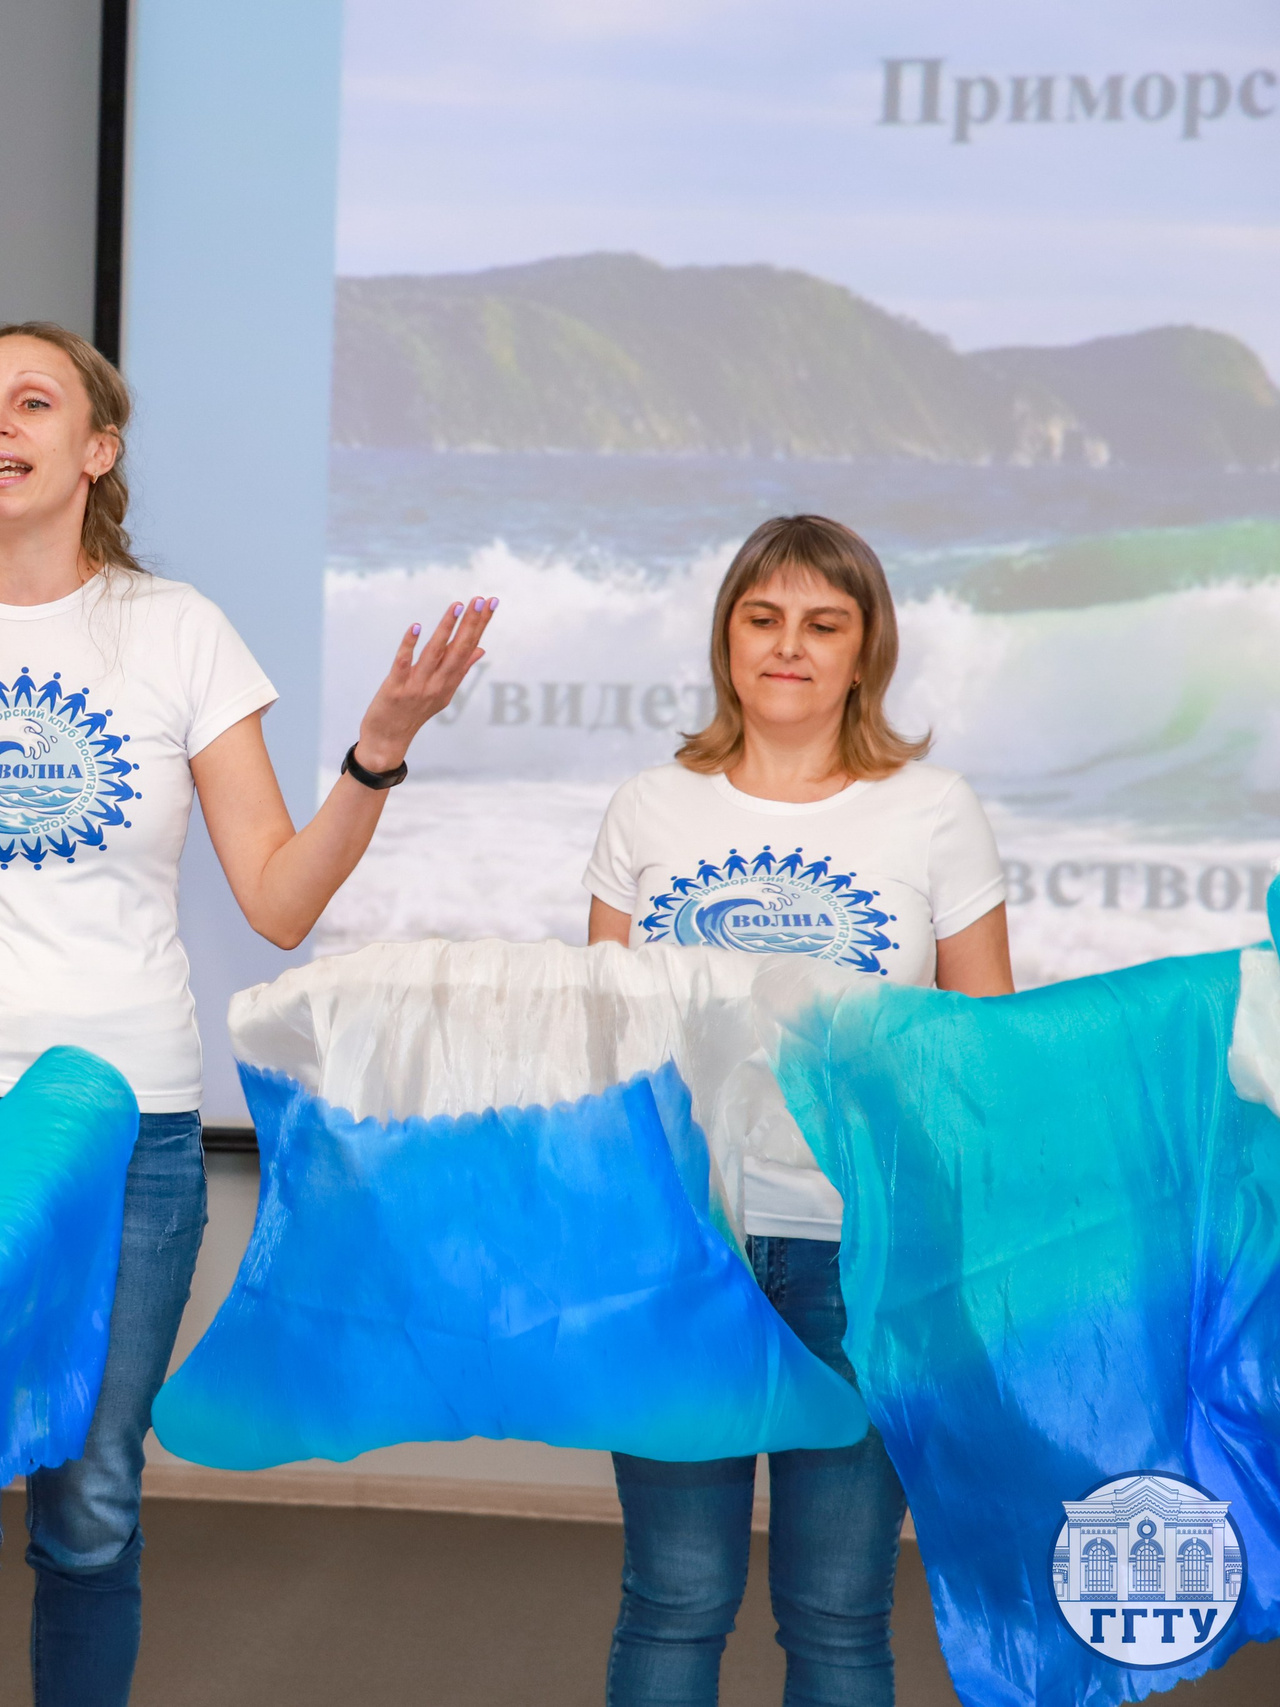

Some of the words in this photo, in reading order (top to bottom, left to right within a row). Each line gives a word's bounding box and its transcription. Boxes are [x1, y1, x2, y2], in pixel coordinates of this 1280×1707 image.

[48, 715, 80, 739] клуб
[67, 738, 96, 816] Воспитатель
[31, 815, 67, 836] года
[689, 874, 786, 901] Приморский
[788, 876, 821, 896] клуб
[732, 913, 835, 928] ВОЛНА
